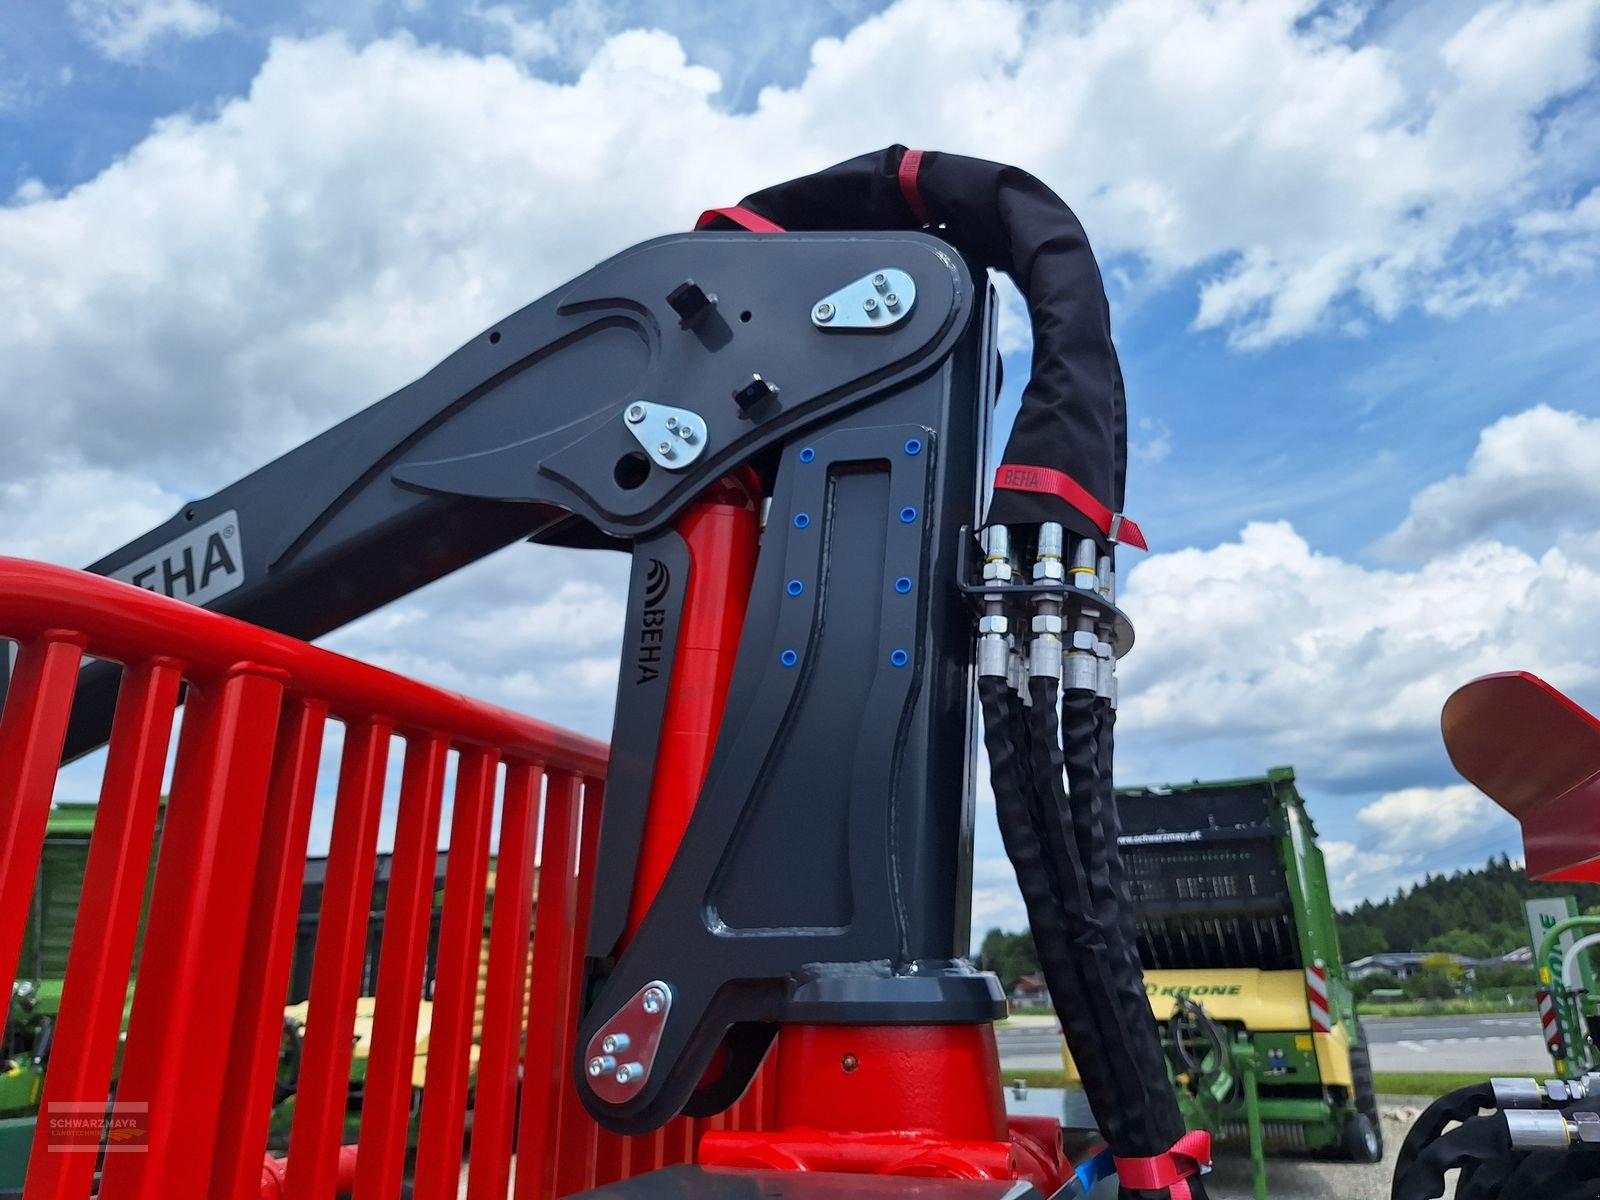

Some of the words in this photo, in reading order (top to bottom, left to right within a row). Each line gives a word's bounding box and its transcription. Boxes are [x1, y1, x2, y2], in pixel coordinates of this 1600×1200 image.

[1004, 469, 1039, 488] BEHA
[132, 531, 237, 598] EHA
[636, 609, 665, 685] BEHA
[1161, 984, 1242, 997] KRONE
